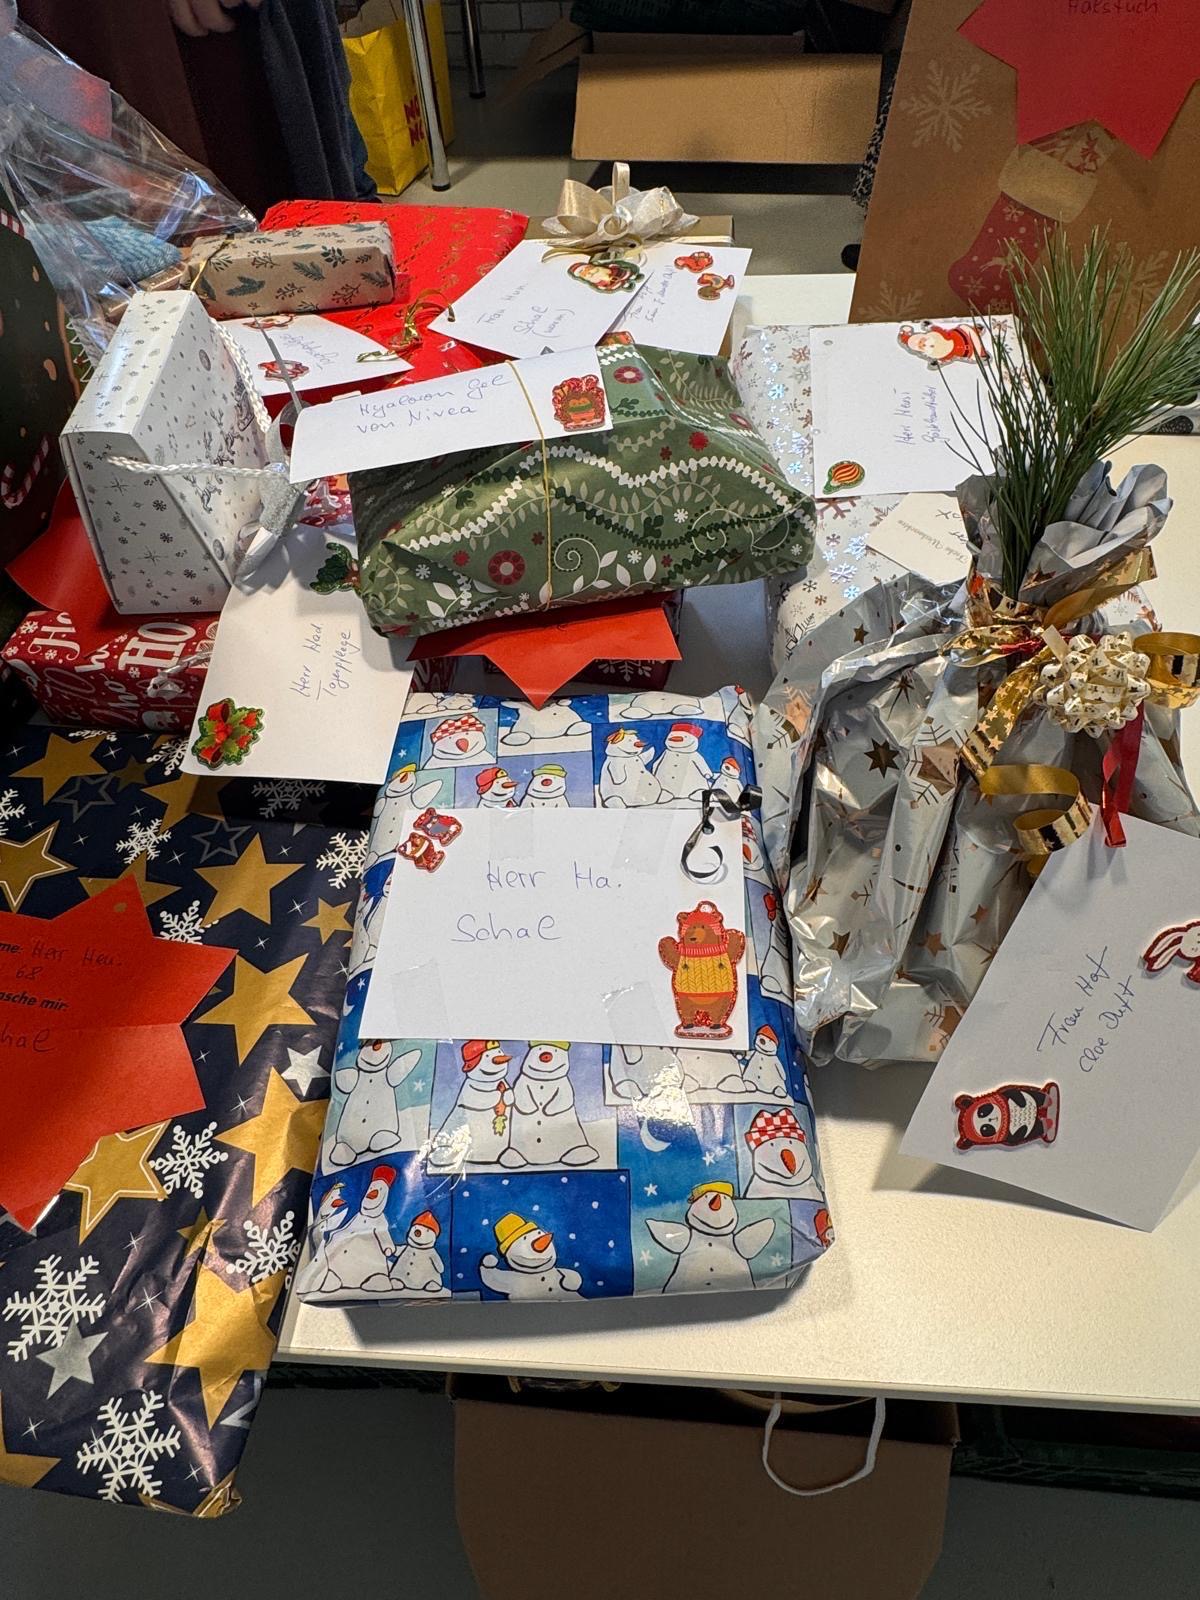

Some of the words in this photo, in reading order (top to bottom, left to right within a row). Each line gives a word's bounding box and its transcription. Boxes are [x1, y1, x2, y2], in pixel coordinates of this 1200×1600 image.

[357, 420, 395, 434] von
[408, 404, 477, 427] Nivea
[289, 664, 312, 698] Herr
[486, 860, 547, 891] Herr
[573, 861, 622, 889] Ha.
[450, 912, 563, 942] Schal
[1036, 1006, 1084, 1052] Frau
